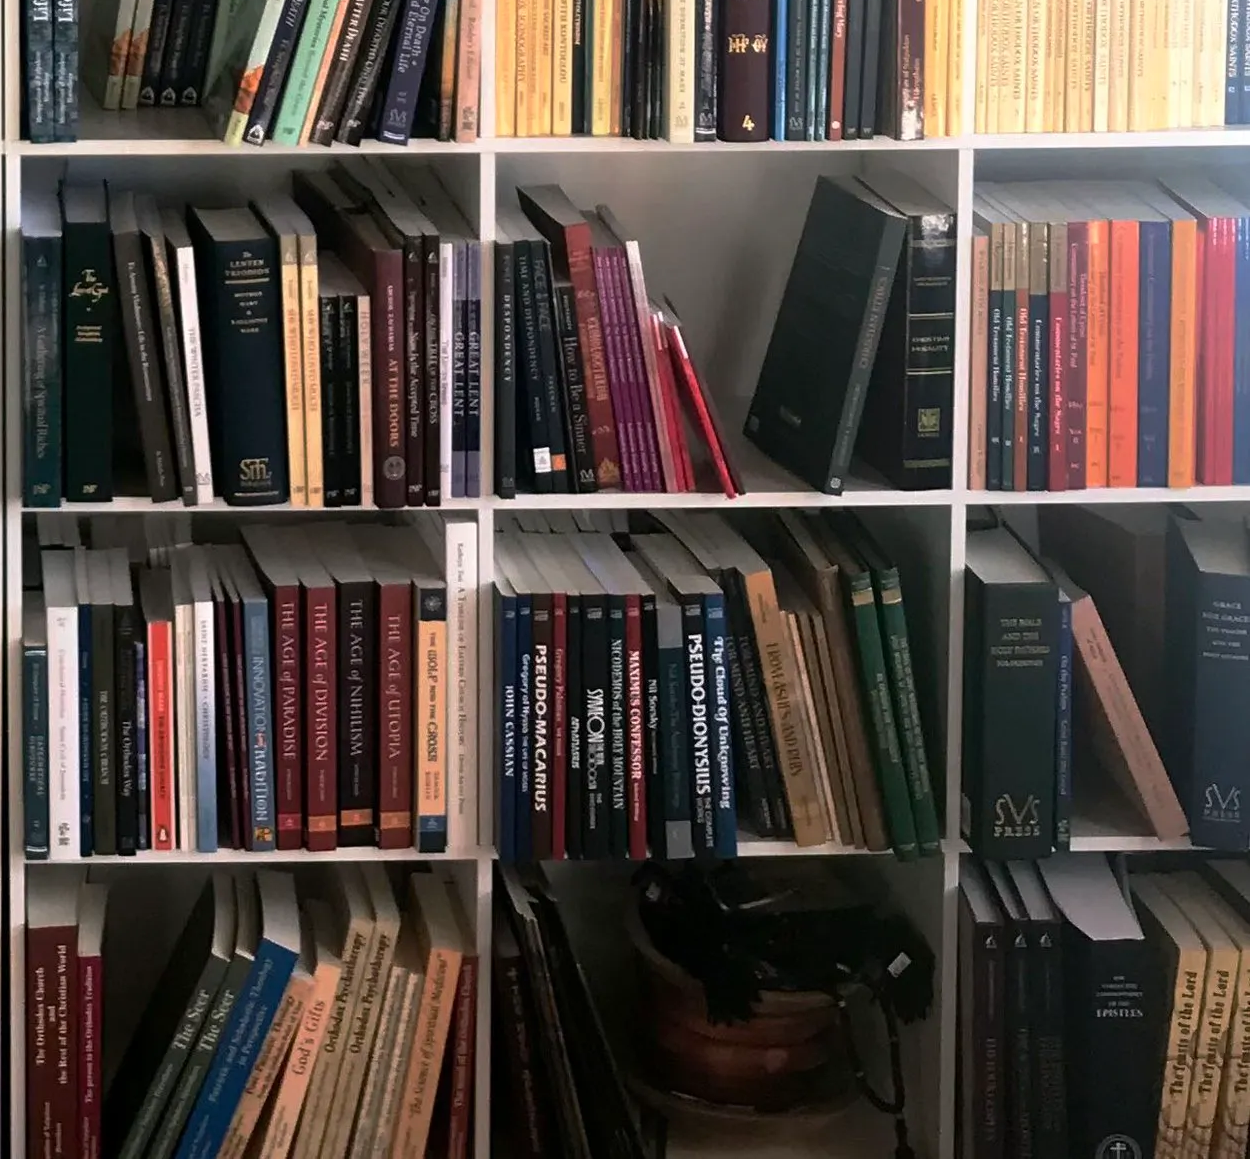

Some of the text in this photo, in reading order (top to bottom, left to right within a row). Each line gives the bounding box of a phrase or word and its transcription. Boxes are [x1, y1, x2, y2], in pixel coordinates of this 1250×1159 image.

[742, 115, 755, 131] 4
[389, 359, 399, 447] AT THE DOORS
[469, 331, 479, 416] GREAT LENT
[385, 614, 401, 758] THE AGE of UTOPIA
[505, 685, 514, 777] JOHN CASSIAN
[534, 645, 547, 811] PSEUDO-MACARIUS
[629, 651, 641, 779] MAXIMUS CONFESSOR
[688, 634, 710, 794] PSEUDO-DIONYSIUS
[711, 637, 730, 808] The Cloud Of Unknowing
